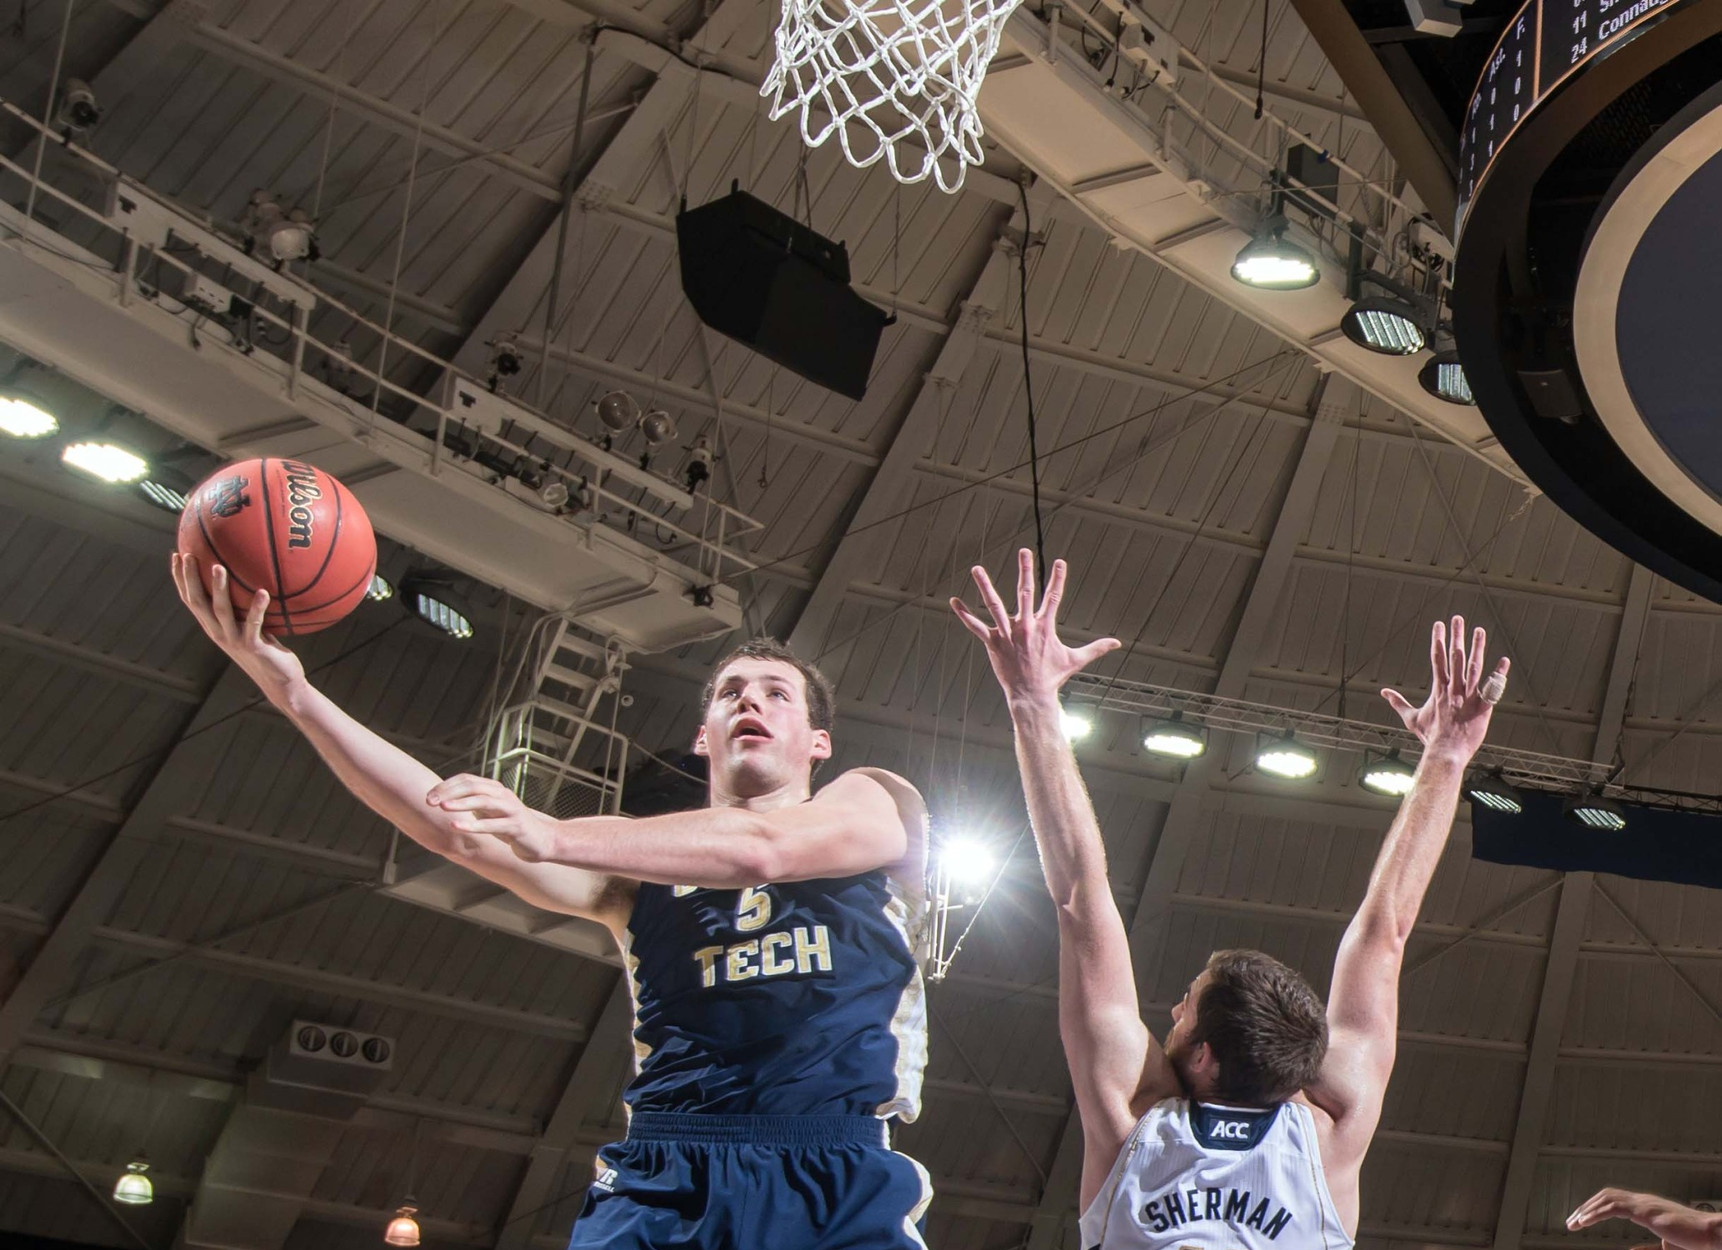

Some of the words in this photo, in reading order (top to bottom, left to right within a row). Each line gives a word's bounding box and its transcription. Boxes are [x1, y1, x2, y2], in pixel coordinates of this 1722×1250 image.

[1573, 10, 1587, 34] 11
[1571, 37, 1588, 63] 24
[281, 461, 323, 550] Wilson
[735, 883, 771, 932] 5
[693, 925, 833, 988] TECH
[1211, 1120, 1250, 1139] ACC
[1144, 1187, 1293, 1240] SHERMAN
